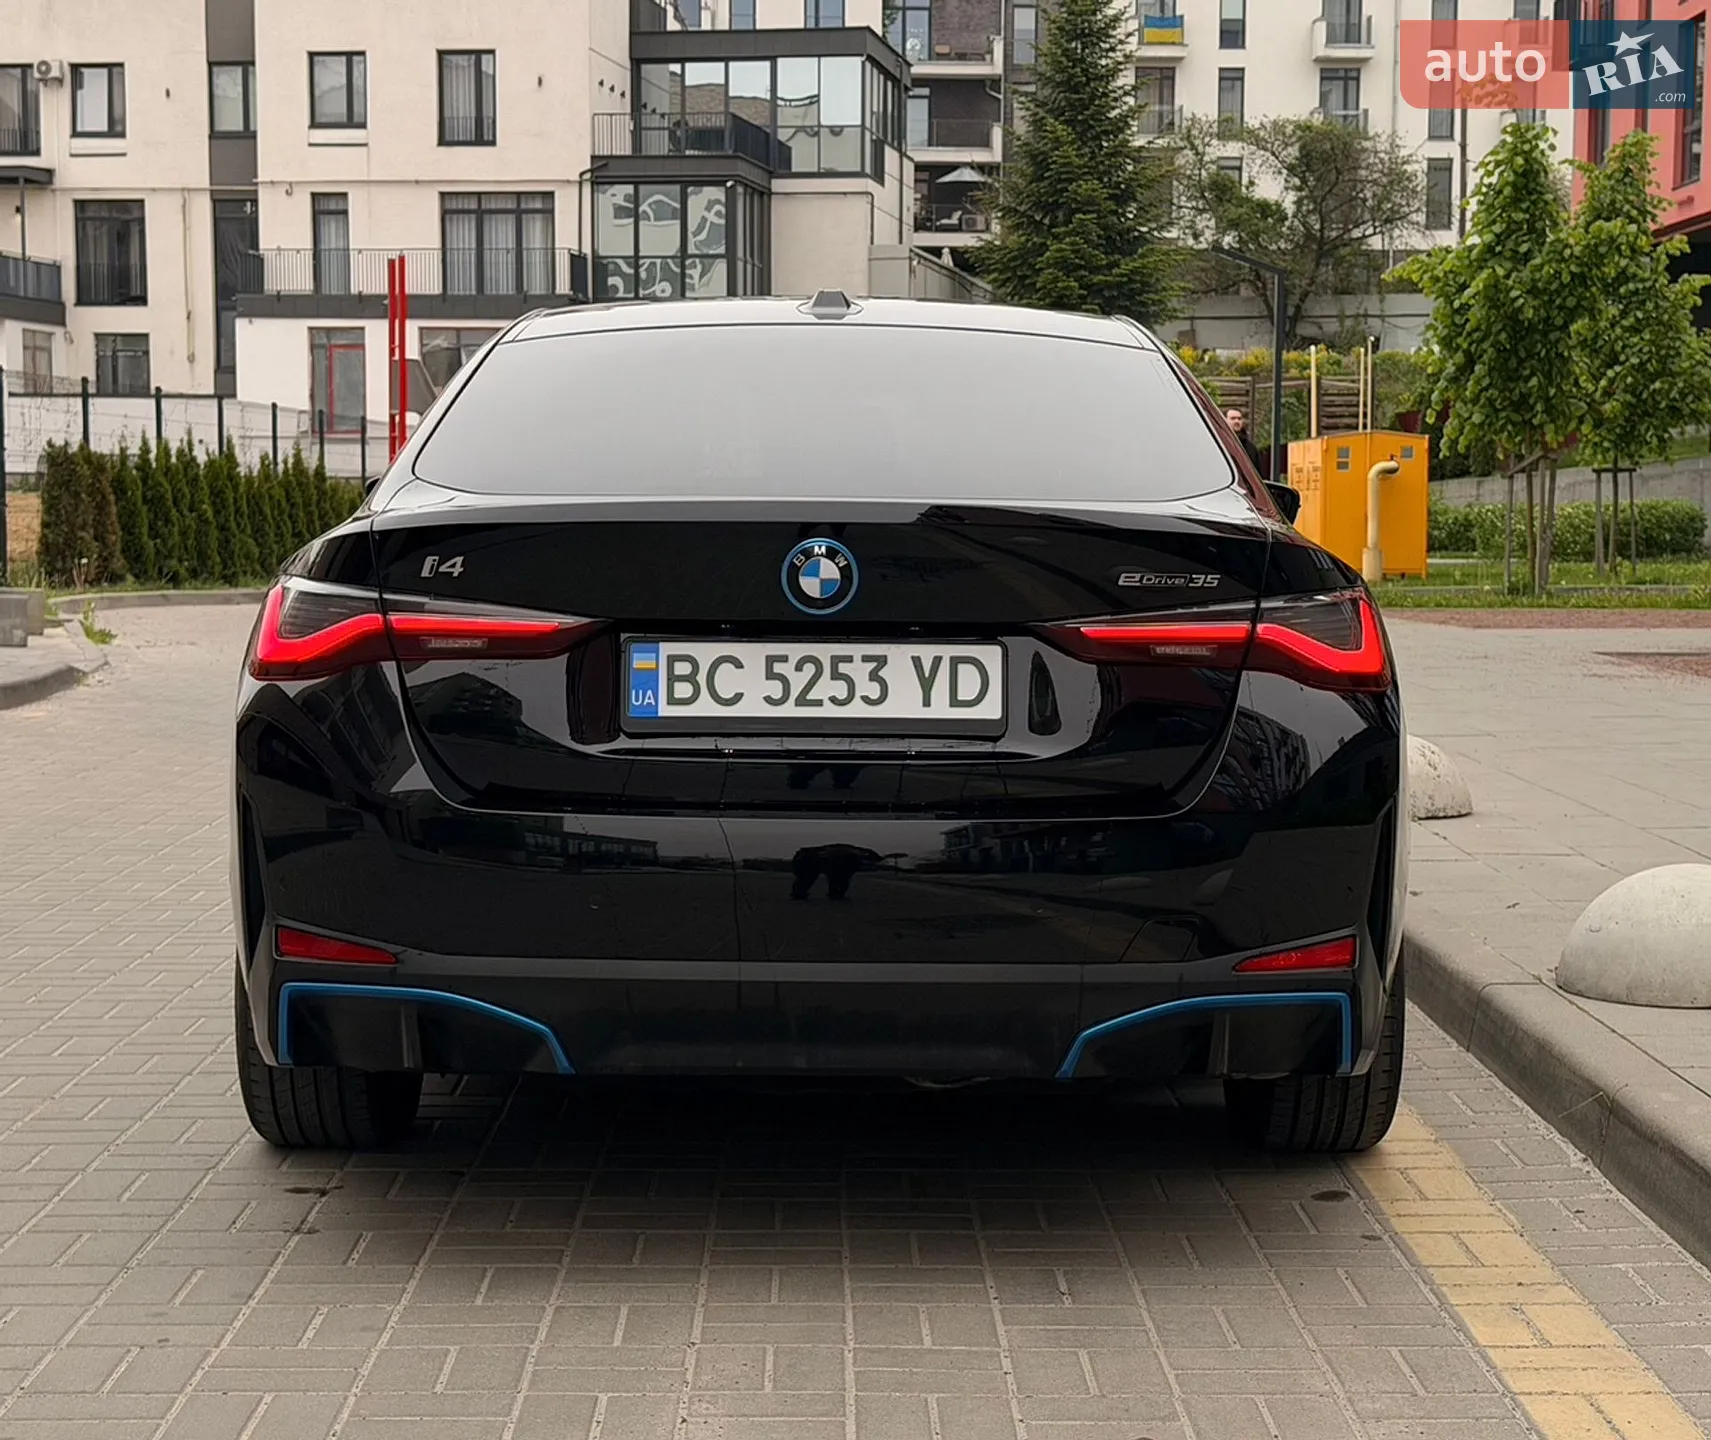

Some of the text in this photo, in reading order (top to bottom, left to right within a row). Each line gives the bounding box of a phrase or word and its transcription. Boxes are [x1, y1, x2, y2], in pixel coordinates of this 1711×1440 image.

[420, 555, 465, 578] i4
[792, 545, 849, 568] BMW
[666, 653, 990, 708] BC 5253 YD
[631, 688, 656, 706] UA
